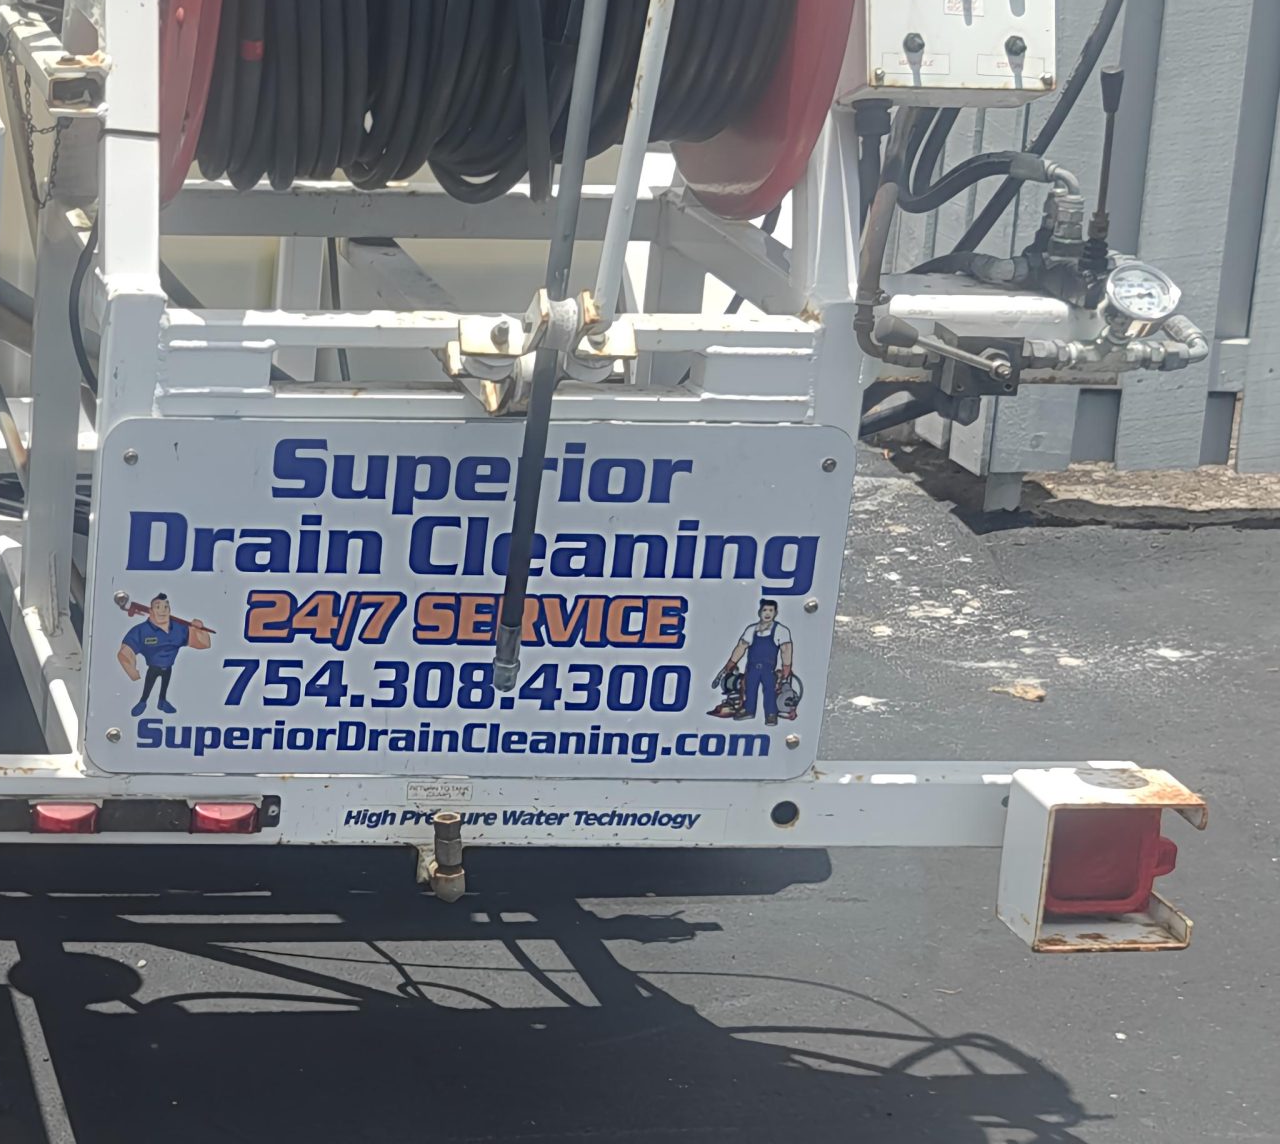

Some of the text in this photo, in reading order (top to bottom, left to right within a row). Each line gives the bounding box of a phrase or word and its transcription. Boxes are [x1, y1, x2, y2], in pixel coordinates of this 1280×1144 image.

[271, 438, 694, 515] Supeior
[126, 511, 821, 596] Drain Cleaning
[244, 590, 407, 648] 24/7
[222, 658, 692, 713] 754.308.4300
[136, 718, 771, 764] SuperiorDrainCleaning.com
[344, 810, 701, 829] High Preure Water Technology
